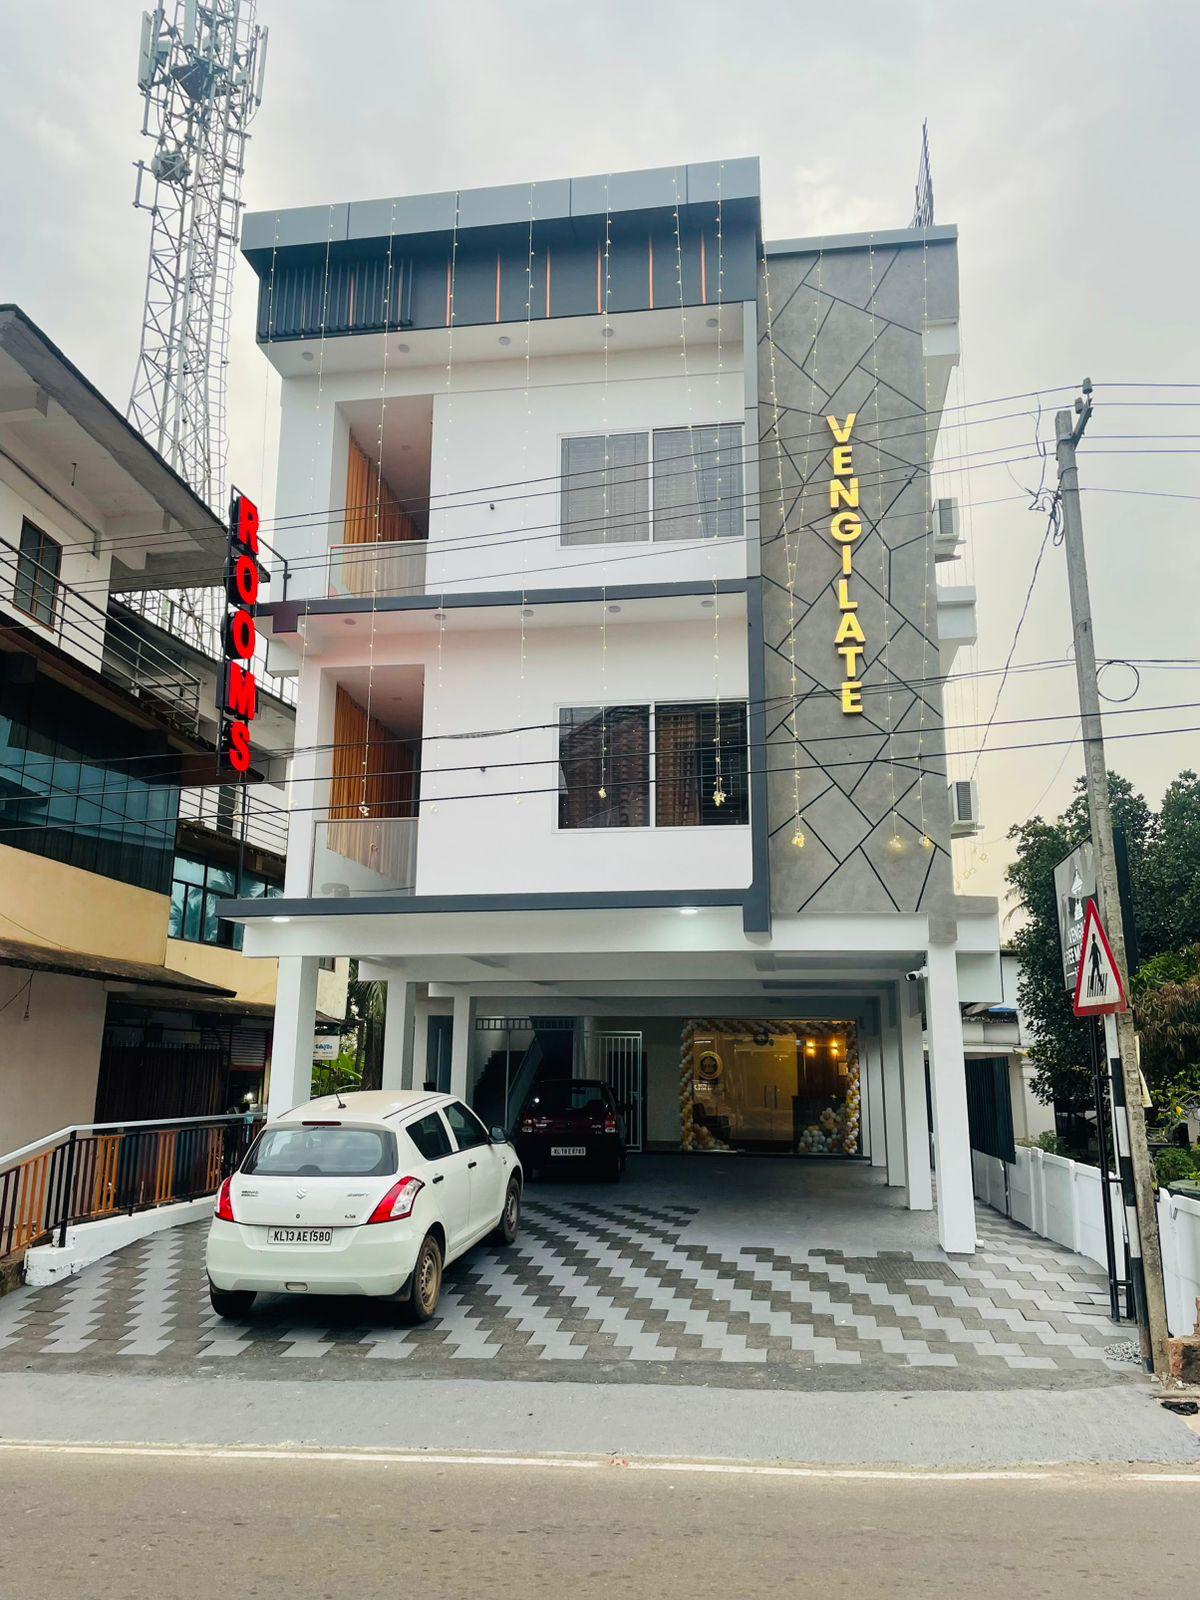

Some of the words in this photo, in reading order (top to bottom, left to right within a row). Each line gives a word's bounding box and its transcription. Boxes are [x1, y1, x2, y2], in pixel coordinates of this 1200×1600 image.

[228, 495, 260, 772] ROOMS
[825, 412, 866, 715] VENGILATE
[273, 1230, 295, 1242] KL13
